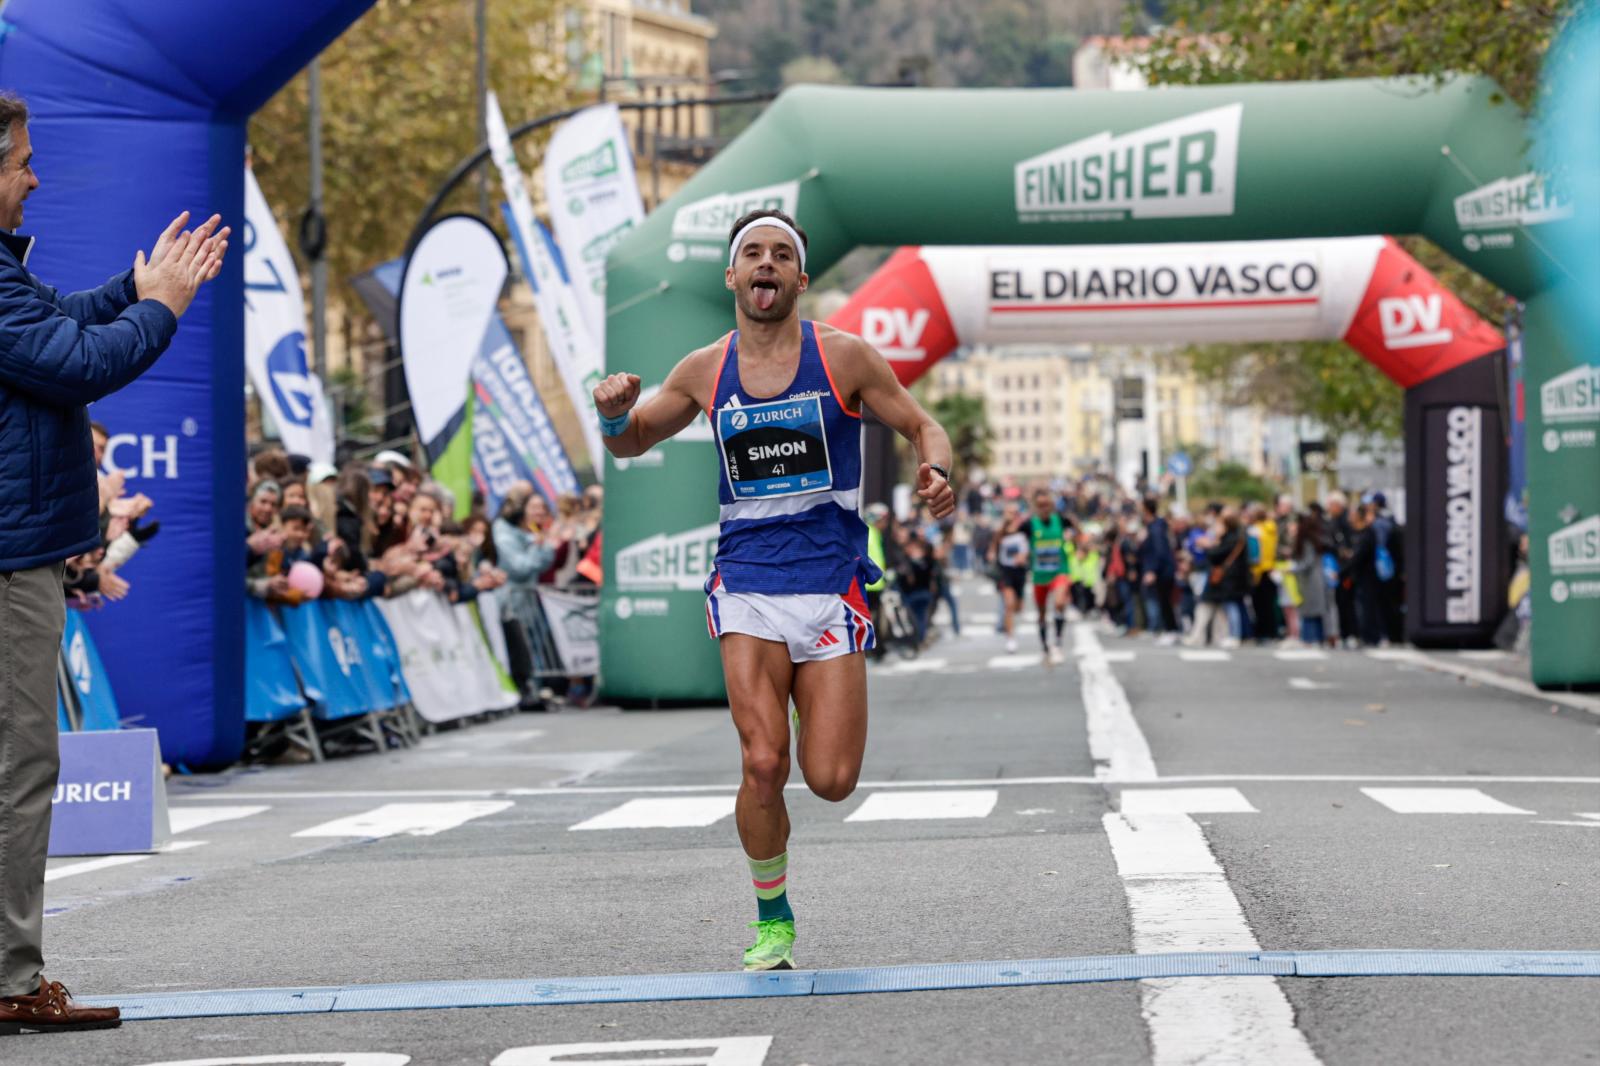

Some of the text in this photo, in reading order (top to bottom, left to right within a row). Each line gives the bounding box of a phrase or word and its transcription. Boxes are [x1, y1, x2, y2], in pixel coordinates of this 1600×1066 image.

[1024, 129, 1216, 206] FINISHER
[990, 262, 1318, 300] EL DIARIO VASCO
[862, 307, 930, 349] DV
[1378, 294, 1442, 337] DV
[753, 408, 802, 424] ZURICH
[748, 441, 807, 461] SIMON
[772, 464, 785, 476] 41
[1446, 406, 1471, 497] VASCO
[1446, 498, 1471, 591] DIARIO
